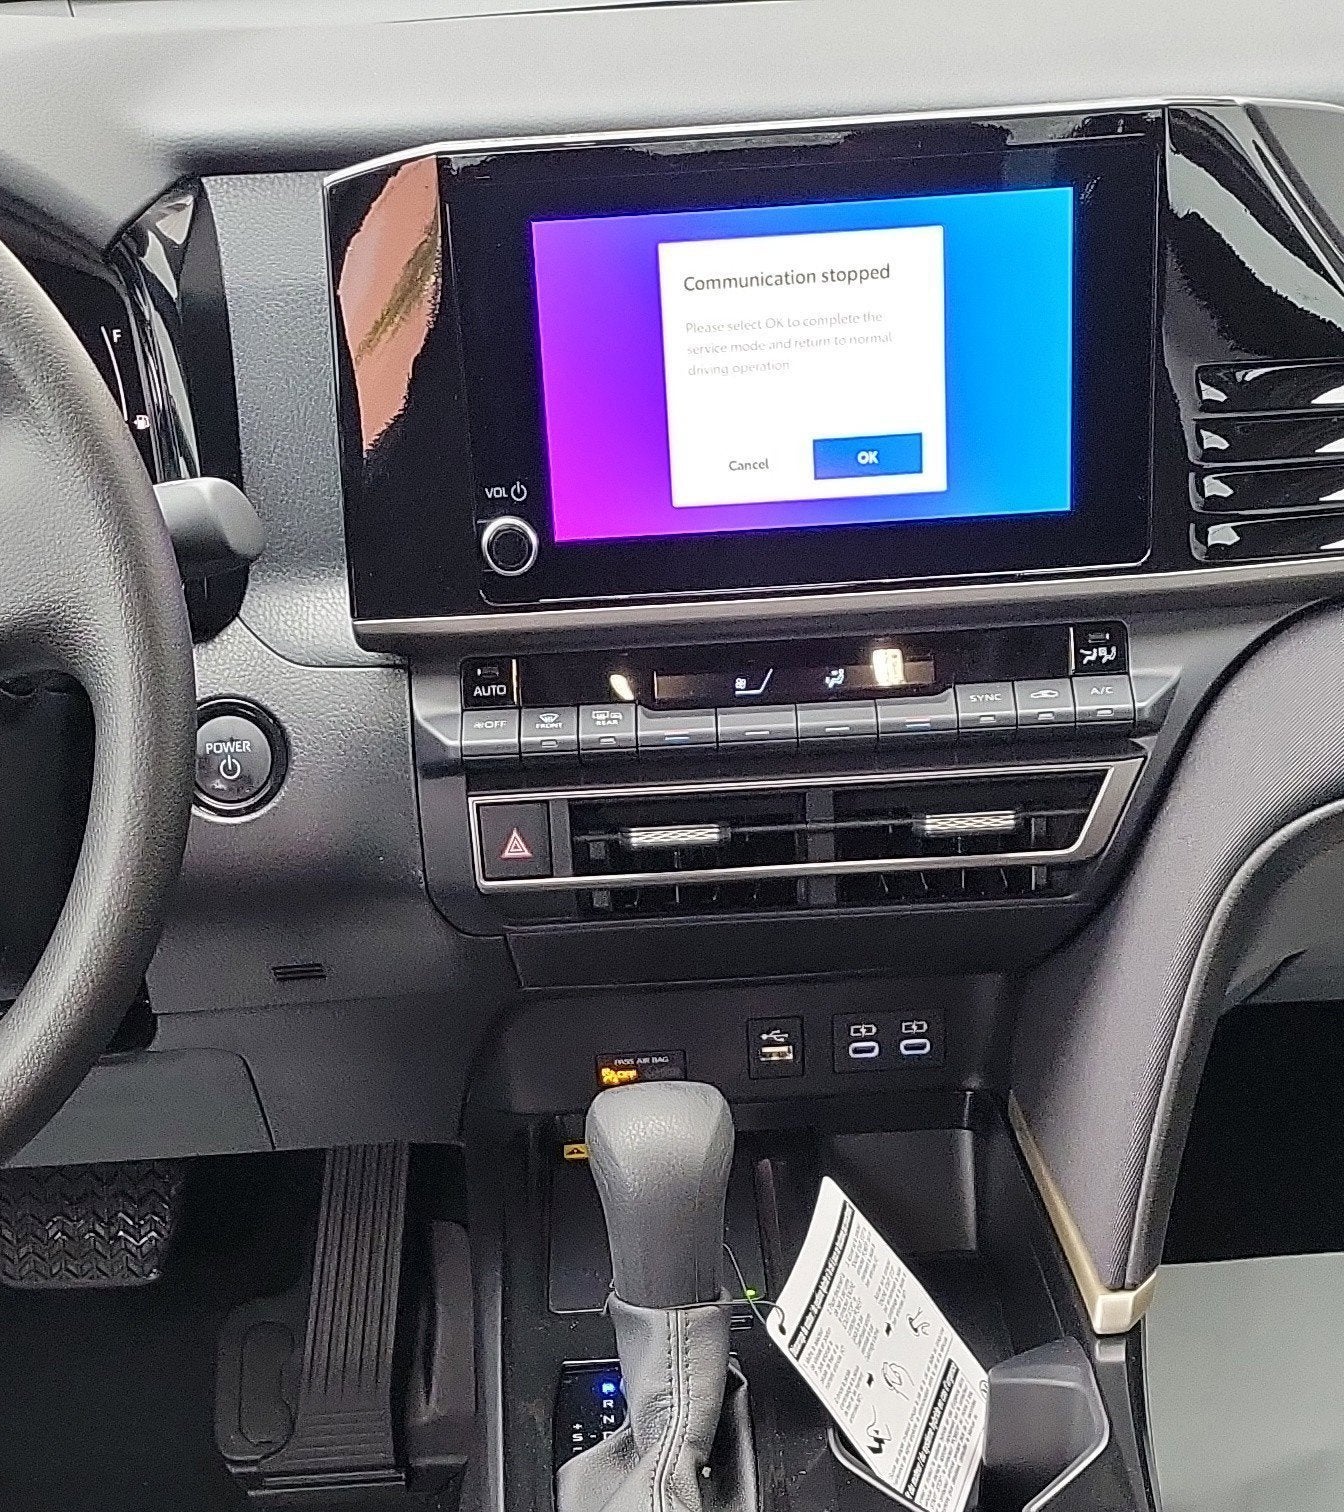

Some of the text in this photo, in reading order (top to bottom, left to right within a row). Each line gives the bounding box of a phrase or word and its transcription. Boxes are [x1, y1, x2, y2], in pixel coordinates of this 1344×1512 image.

[684, 263, 891, 292] Communication stopped
[686, 311, 883, 334] Please select OK to complete the
[687, 331, 893, 355] service mode and return to normal
[688, 364, 729, 377] driving
[857, 450, 879, 465] OK
[728, 457, 770, 472] Cancel
[484, 487, 508, 499] VOL
[473, 684, 506, 697] AUTO
[1090, 686, 1114, 695] A/C
[969, 693, 1002, 702] SYNC
[485, 720, 508, 729] OFF
[536, 721, 563, 729] FRONT
[205, 740, 252, 755] POWER
[603, 1400, 614, 1408] R
[603, 1415, 615, 1424] N
